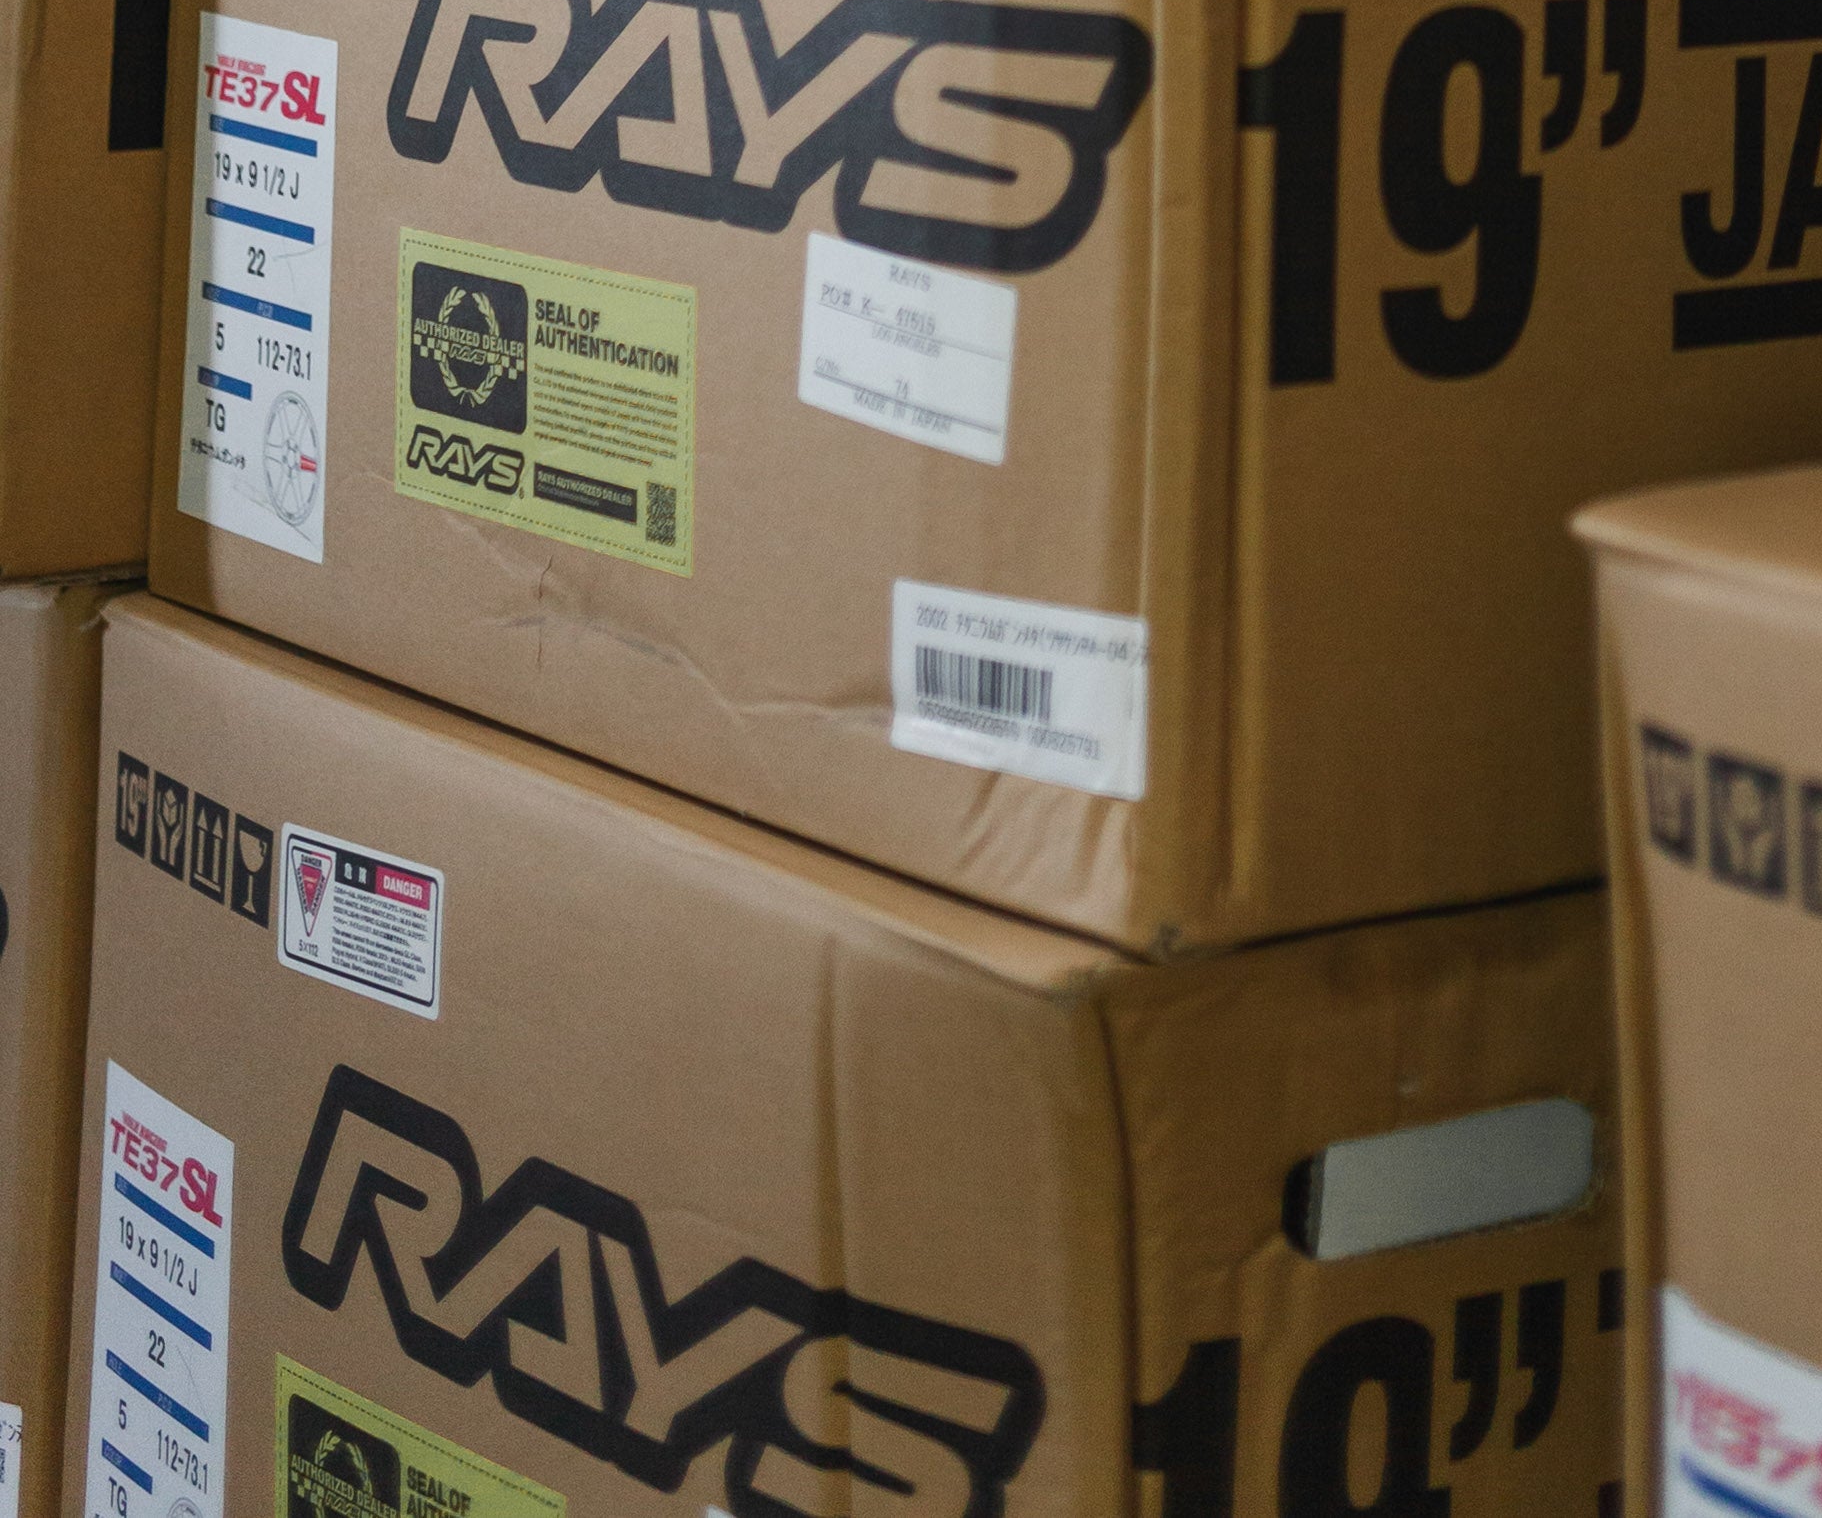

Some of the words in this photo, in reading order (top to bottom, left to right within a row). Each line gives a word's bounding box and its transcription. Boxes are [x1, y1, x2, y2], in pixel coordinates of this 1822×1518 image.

[214, 150, 231, 181] 19
[249, 161, 258, 188] 9
[263, 165, 285, 197] 1/2
[290, 171, 300, 200] J
[246, 246, 266, 278] 22
[414, 317, 480, 348] AUTHORIZED
[482, 336, 525, 359] DEALER
[534, 298, 575, 330] SEAL
[578, 307, 600, 333] OF
[215, 322, 225, 351] 5
[257, 336, 313, 381] 112-73.1
[534, 324, 679, 379] AUTHENTICATION
[205, 397, 227, 432] TG
[406, 424, 525, 496] RAYS
[383, 875, 424, 900] DANGER
[119, 1215, 134, 1250] 19
[150, 1238, 159, 1268] 9
[163, 1249, 184, 1288] 1/2
[188, 1267, 198, 1296] J
[282, 1064, 1047, 1518] RAYS
[148, 1329, 166, 1368] 22
[118, 1398, 127, 1430] 5
[157, 1429, 208, 1495] 112-73.1
[108, 1476, 128, 1518] TG
[291, 1454, 355, 1501] AUTHORIZED
[406, 1464, 448, 1507] SEAL
[450, 1487, 472, 1515] OF
